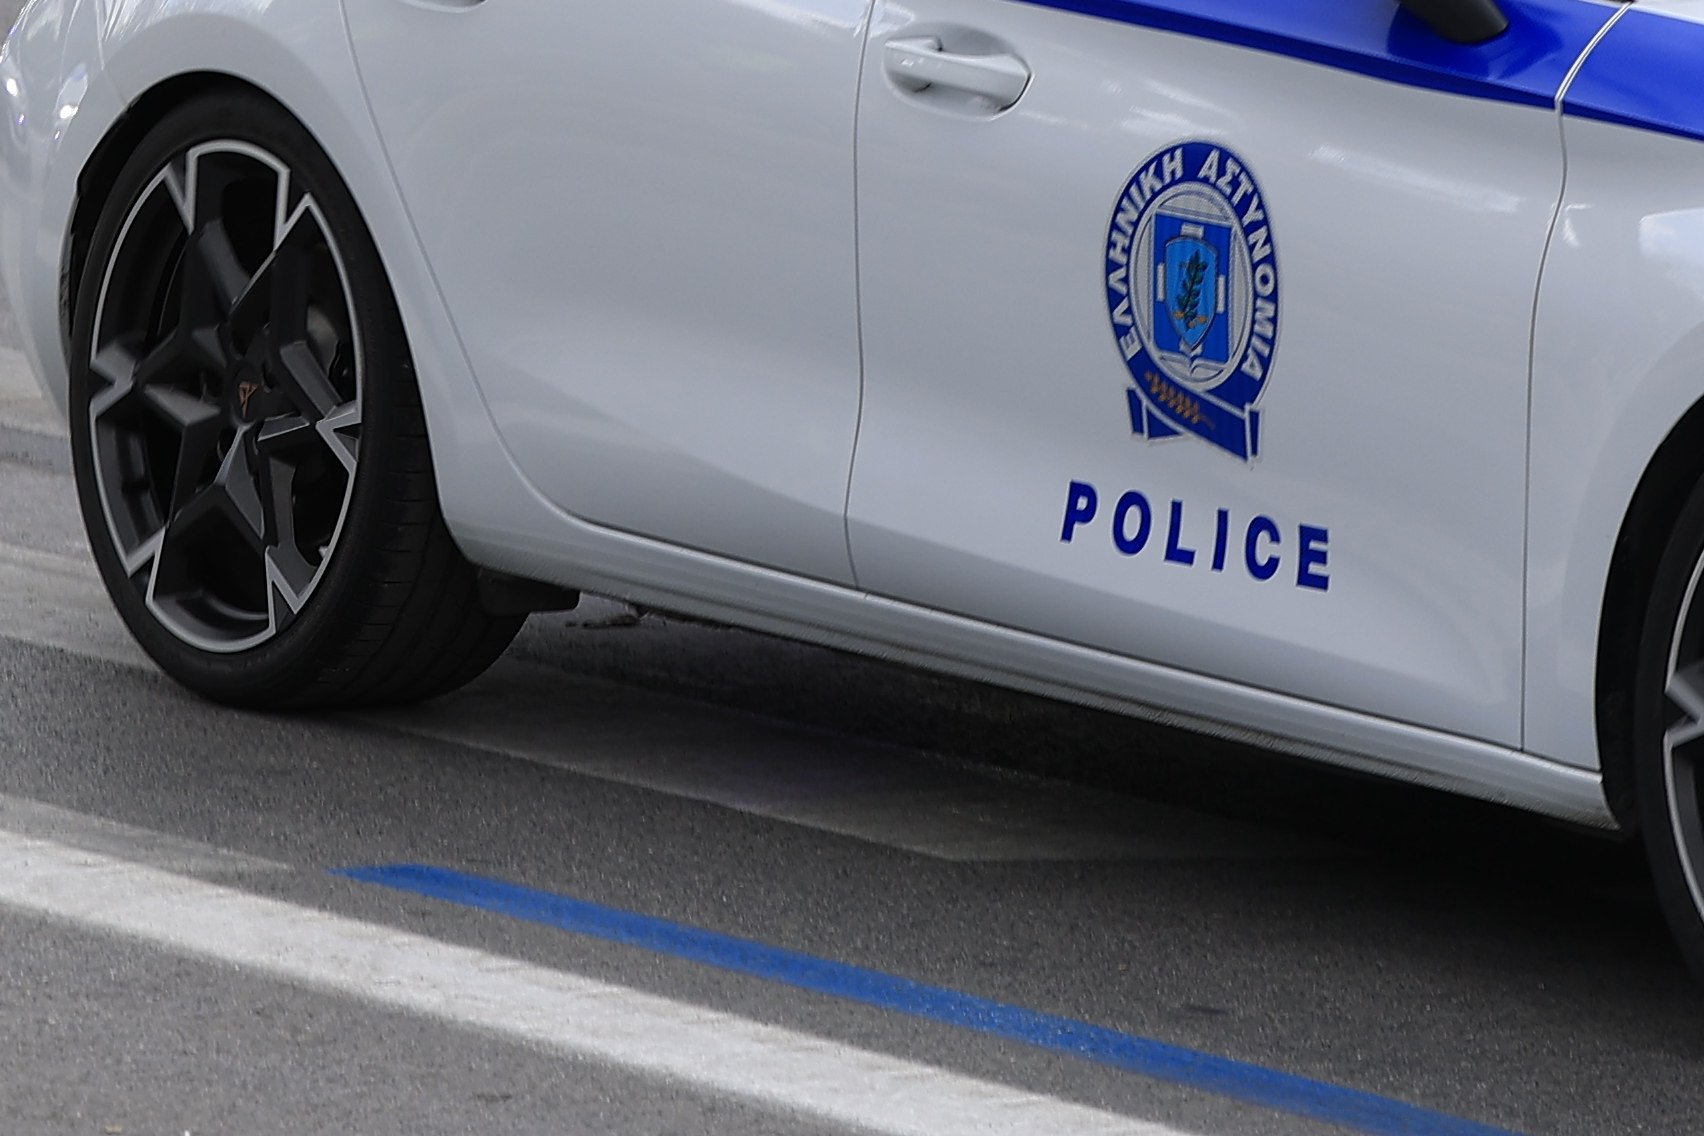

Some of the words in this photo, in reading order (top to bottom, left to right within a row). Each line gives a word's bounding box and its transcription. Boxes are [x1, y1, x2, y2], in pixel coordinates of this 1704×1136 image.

[1106, 147, 1184, 362] ΕΛΛΗΝΙΚΗ
[1197, 148, 1277, 382] ΑΣΤΥΝΟΜΙΑ
[1059, 479, 1331, 593] POLICE
